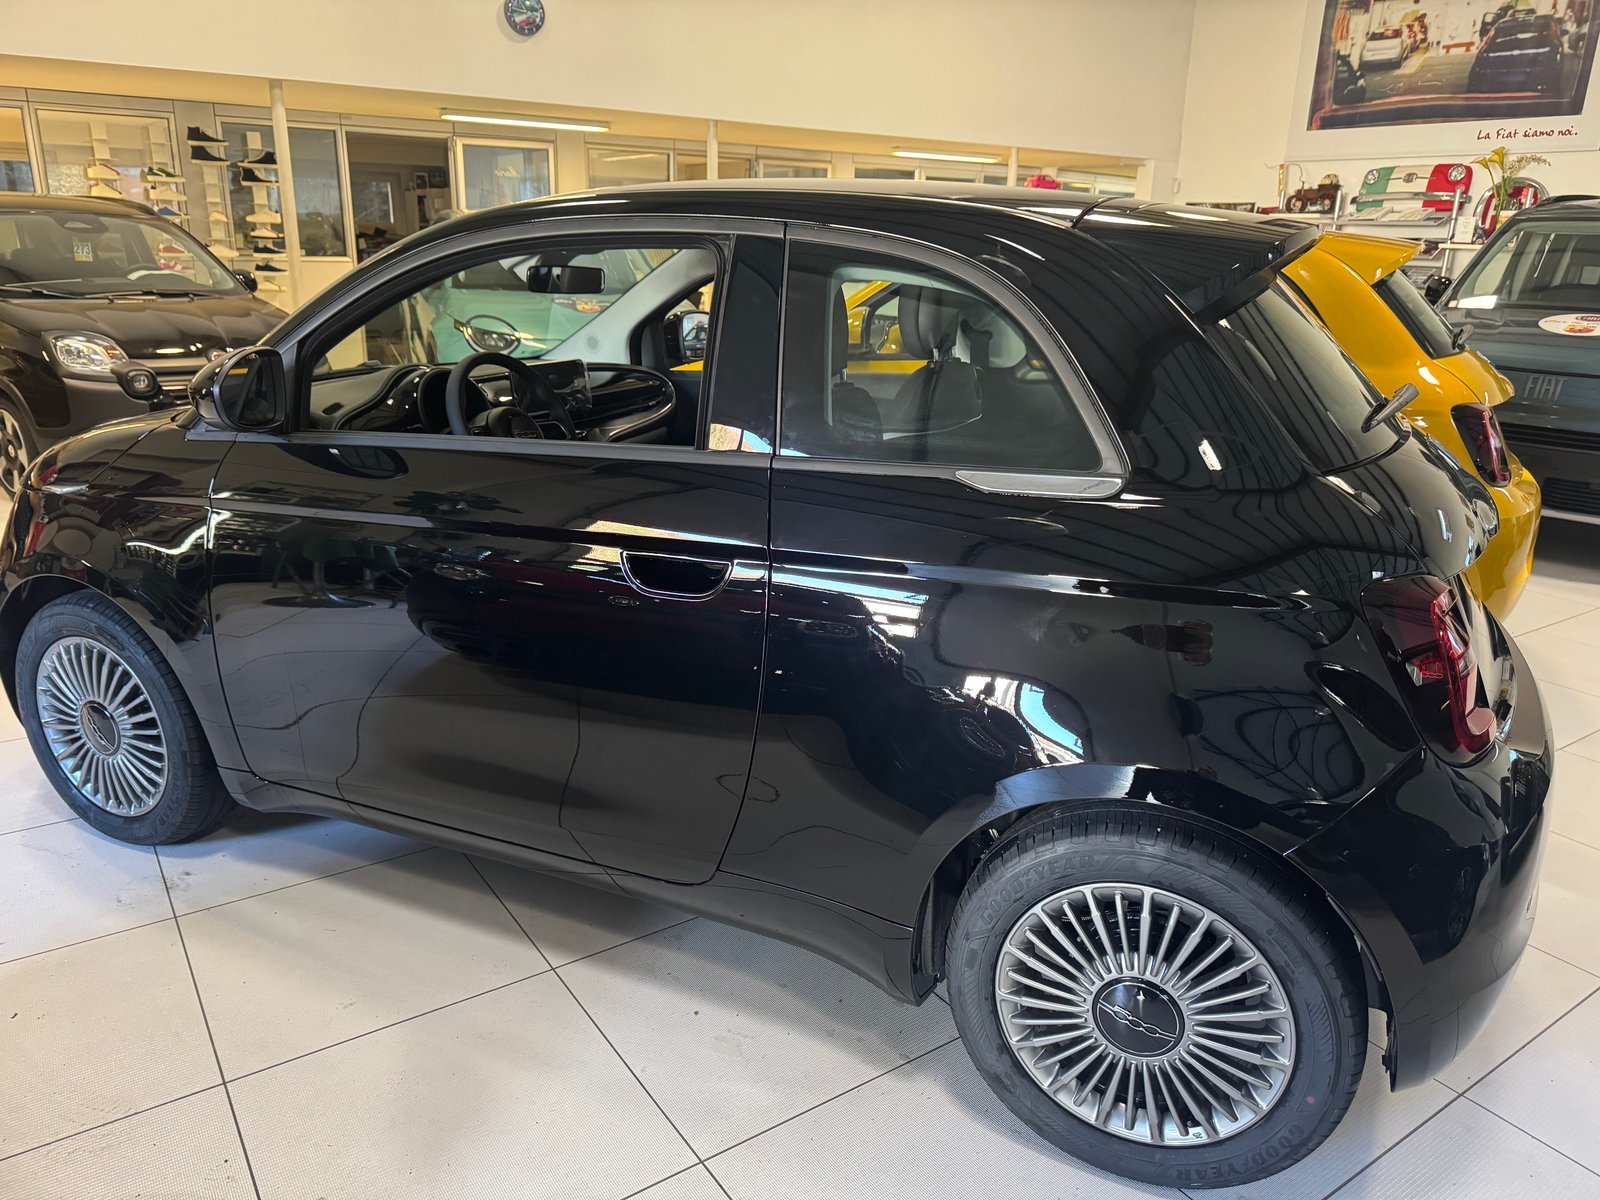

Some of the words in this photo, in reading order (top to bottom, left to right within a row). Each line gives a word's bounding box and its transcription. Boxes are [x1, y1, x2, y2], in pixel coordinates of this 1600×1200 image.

[1477, 129, 1491, 140] La
[1496, 127, 1519, 139] Fiat
[1522, 127, 1554, 138] siamo
[1557, 125, 1578, 136] noi.
[74, 243, 91, 255] 273
[1523, 375, 1568, 401] FIAT
